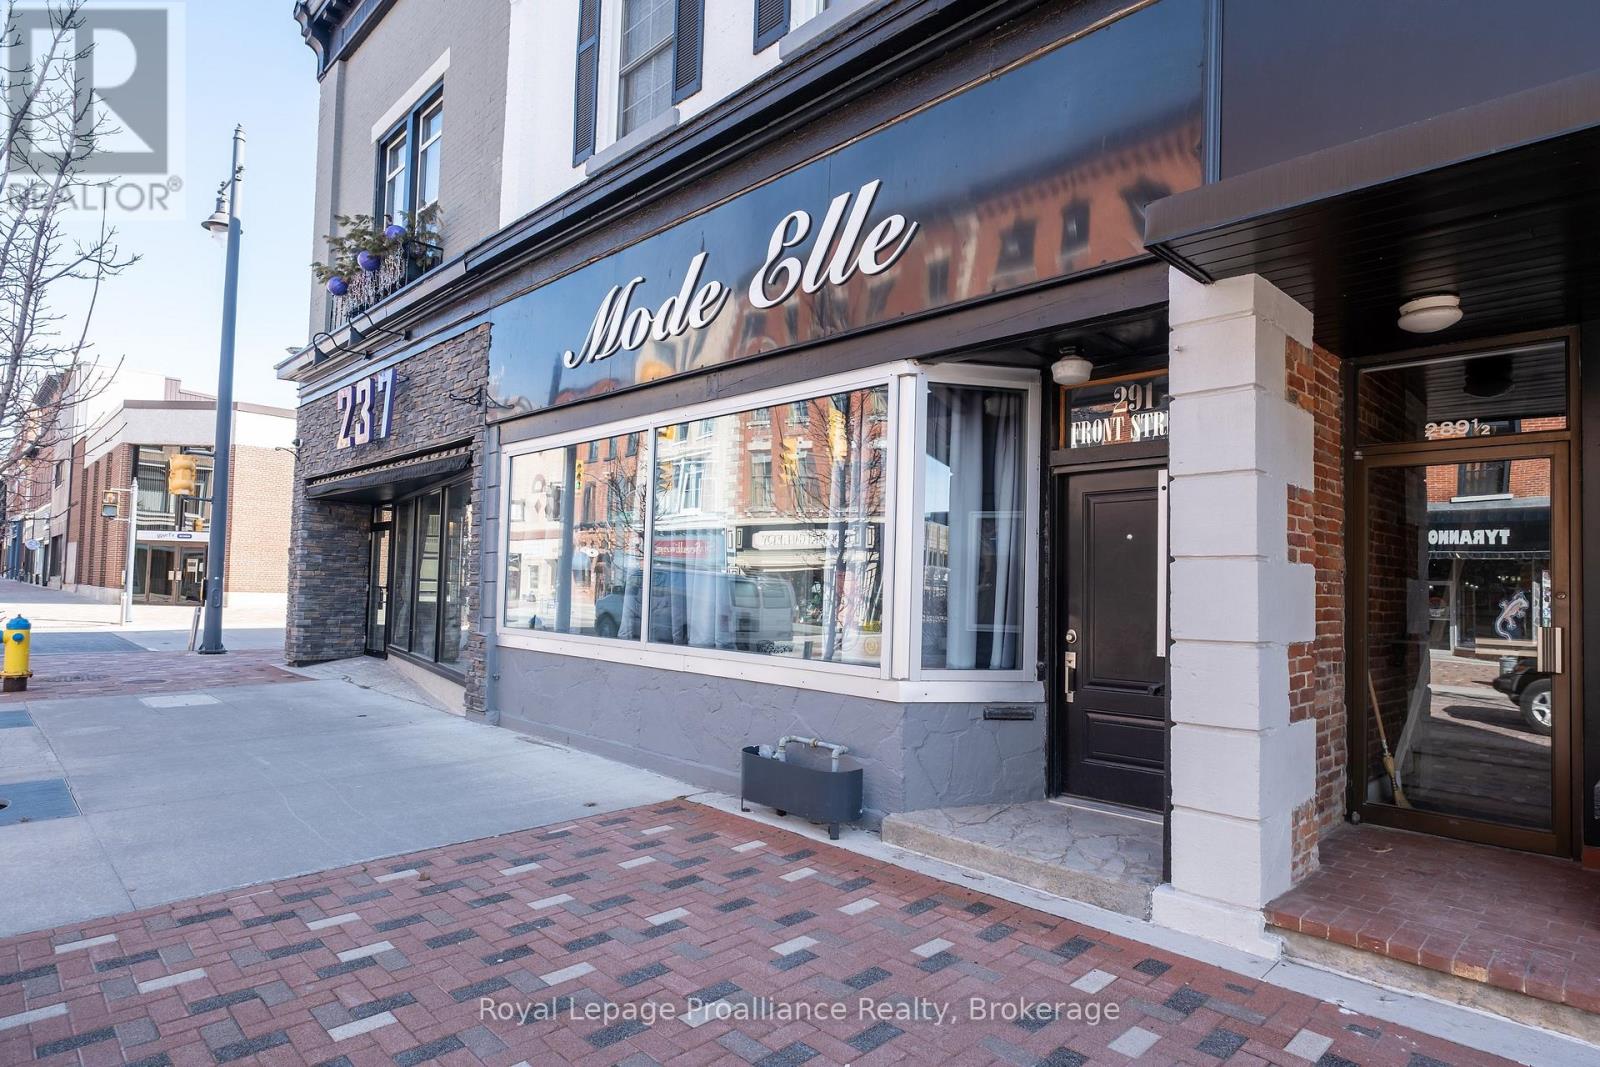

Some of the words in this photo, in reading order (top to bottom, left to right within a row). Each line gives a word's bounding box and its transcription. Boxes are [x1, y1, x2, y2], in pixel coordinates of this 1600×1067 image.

[564, 251, 732, 369] Mode
[748, 178, 920, 310] Elle
[336, 368, 397, 450] 237
[1113, 381, 1154, 413] 291
[1070, 416, 1125, 445] FRONT
[1130, 410, 1169, 440] STR
